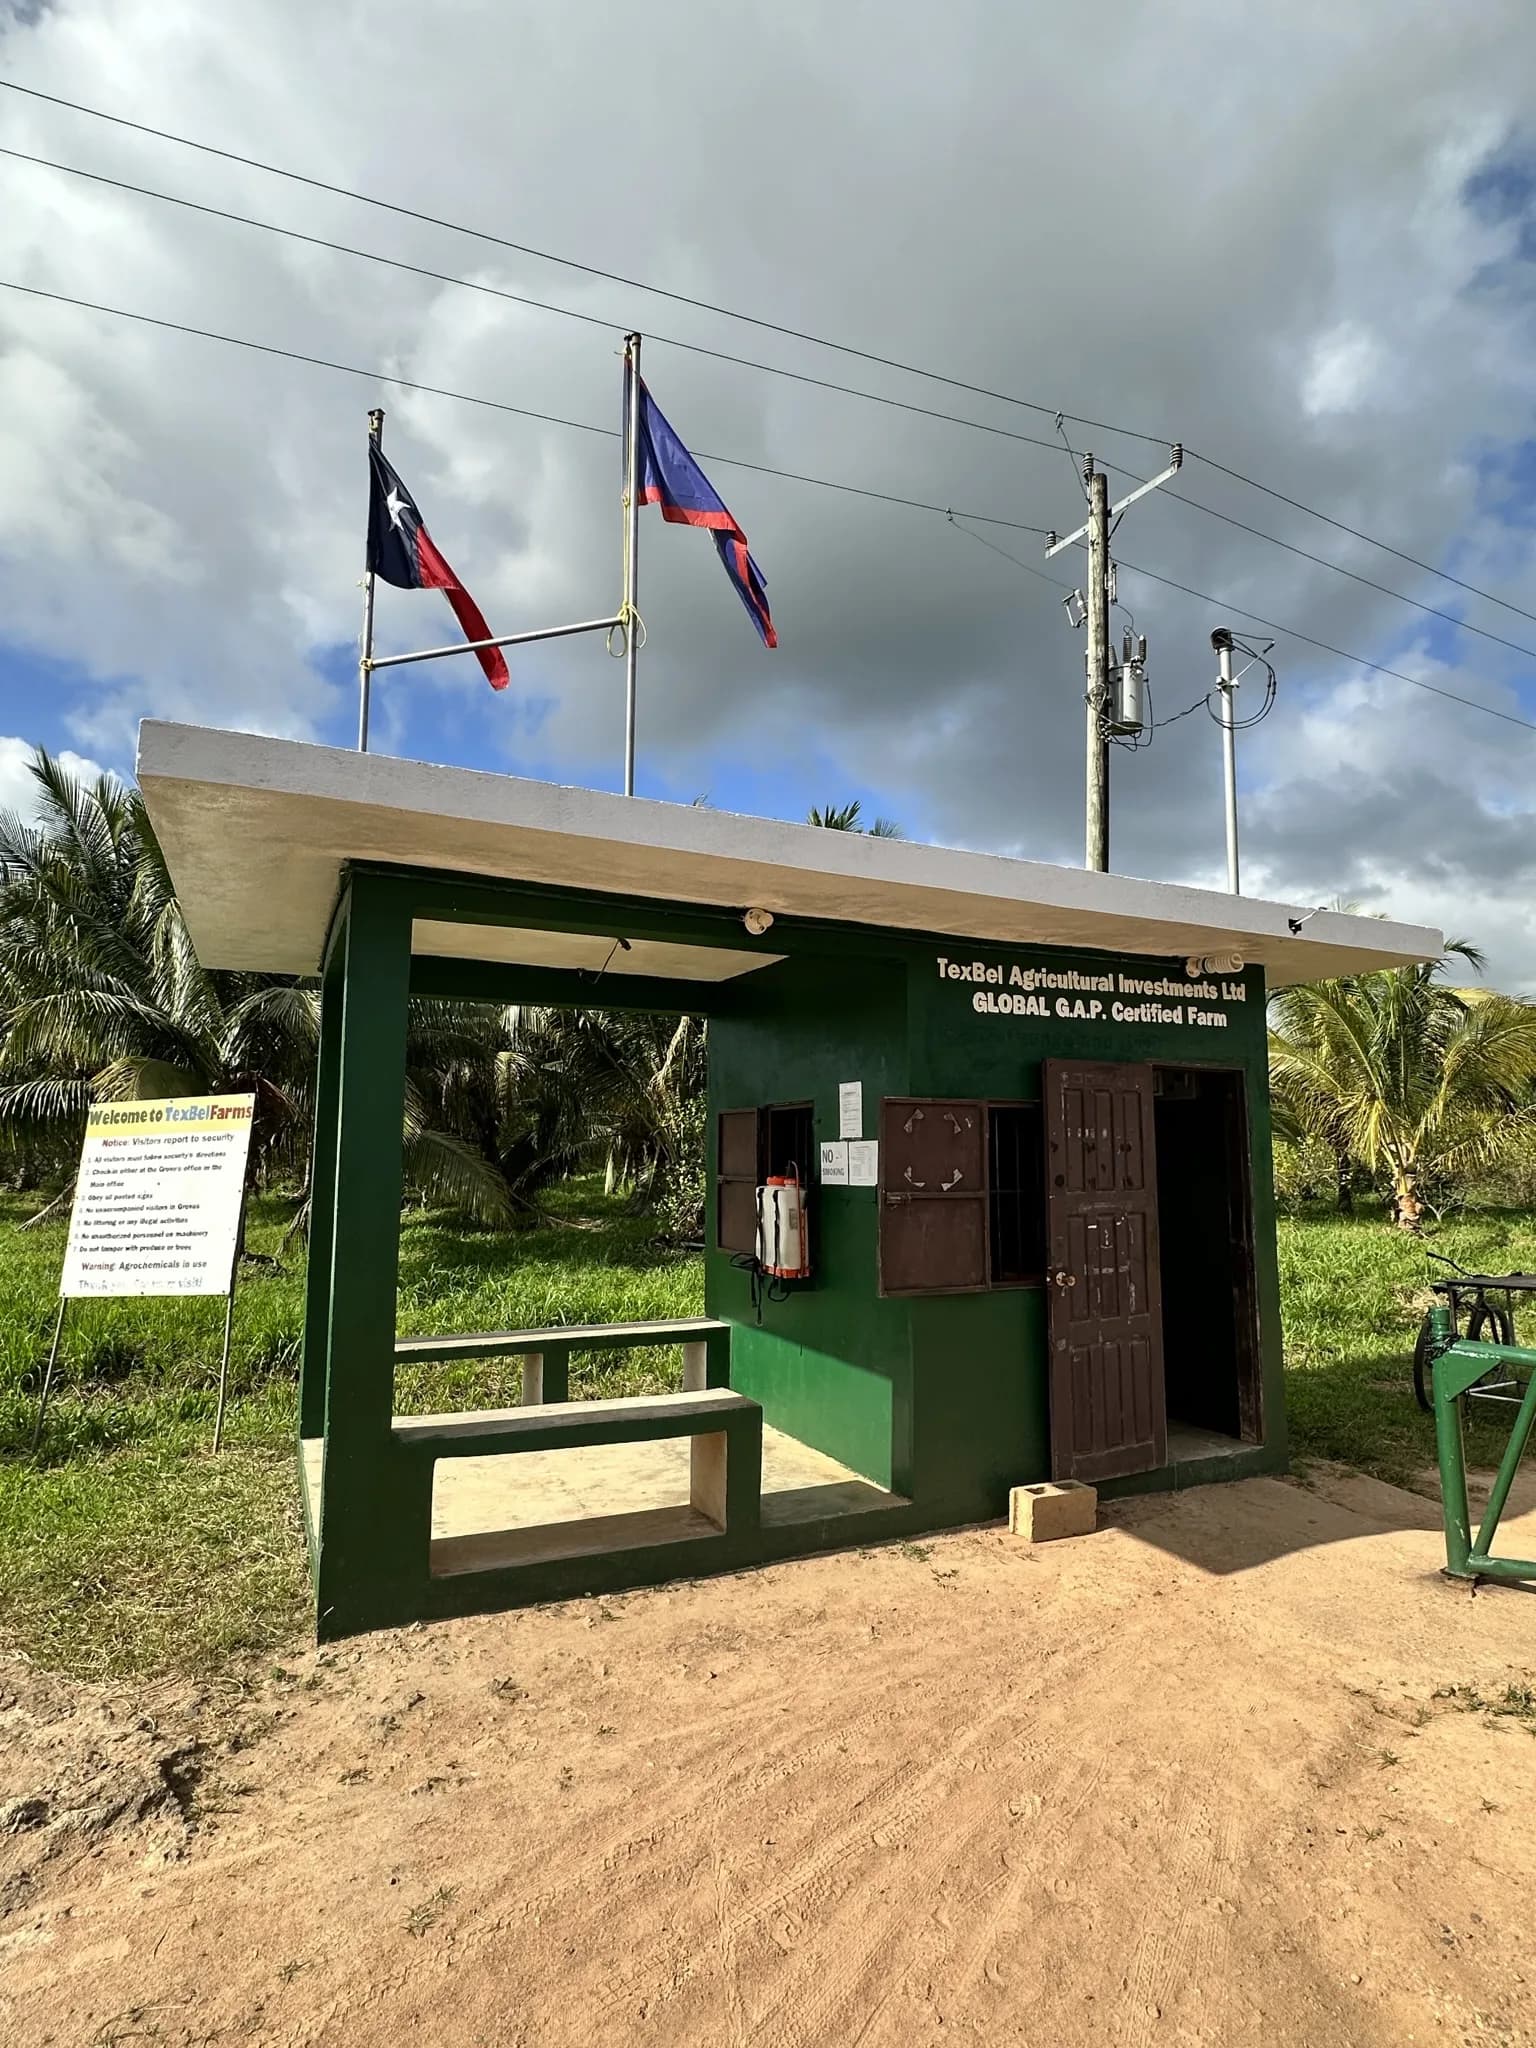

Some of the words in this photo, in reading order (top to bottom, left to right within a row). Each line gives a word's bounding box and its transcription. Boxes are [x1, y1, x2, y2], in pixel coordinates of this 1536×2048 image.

[937, 957, 1003, 985] TexBel
[1008, 965, 1114, 992] Agricultural
[1118, 973, 1218, 999] Investments
[1221, 981, 1246, 1002] Ltd
[972, 992, 1051, 1017] GLOBAL
[1055, 997, 1107, 1020] G.A.P.
[1111, 1001, 1183, 1024] Certified
[1187, 1006, 1228, 1027] Farm
[89, 1109, 148, 1126] Welcome
[149, 1109, 163, 1123] to
[132, 1137, 161, 1146] Visitors
[163, 1136, 189, 1146] report
[190, 1135, 200, 1143] to
[202, 1133, 234, 1143] security
[822, 1149, 834, 1163] NO
[822, 1167, 845, 1176] SMOKING
[118, 1260, 180, 1272] Agrochemicals
[182, 1260, 190, 1268] in
[192, 1260, 207, 1268] use
